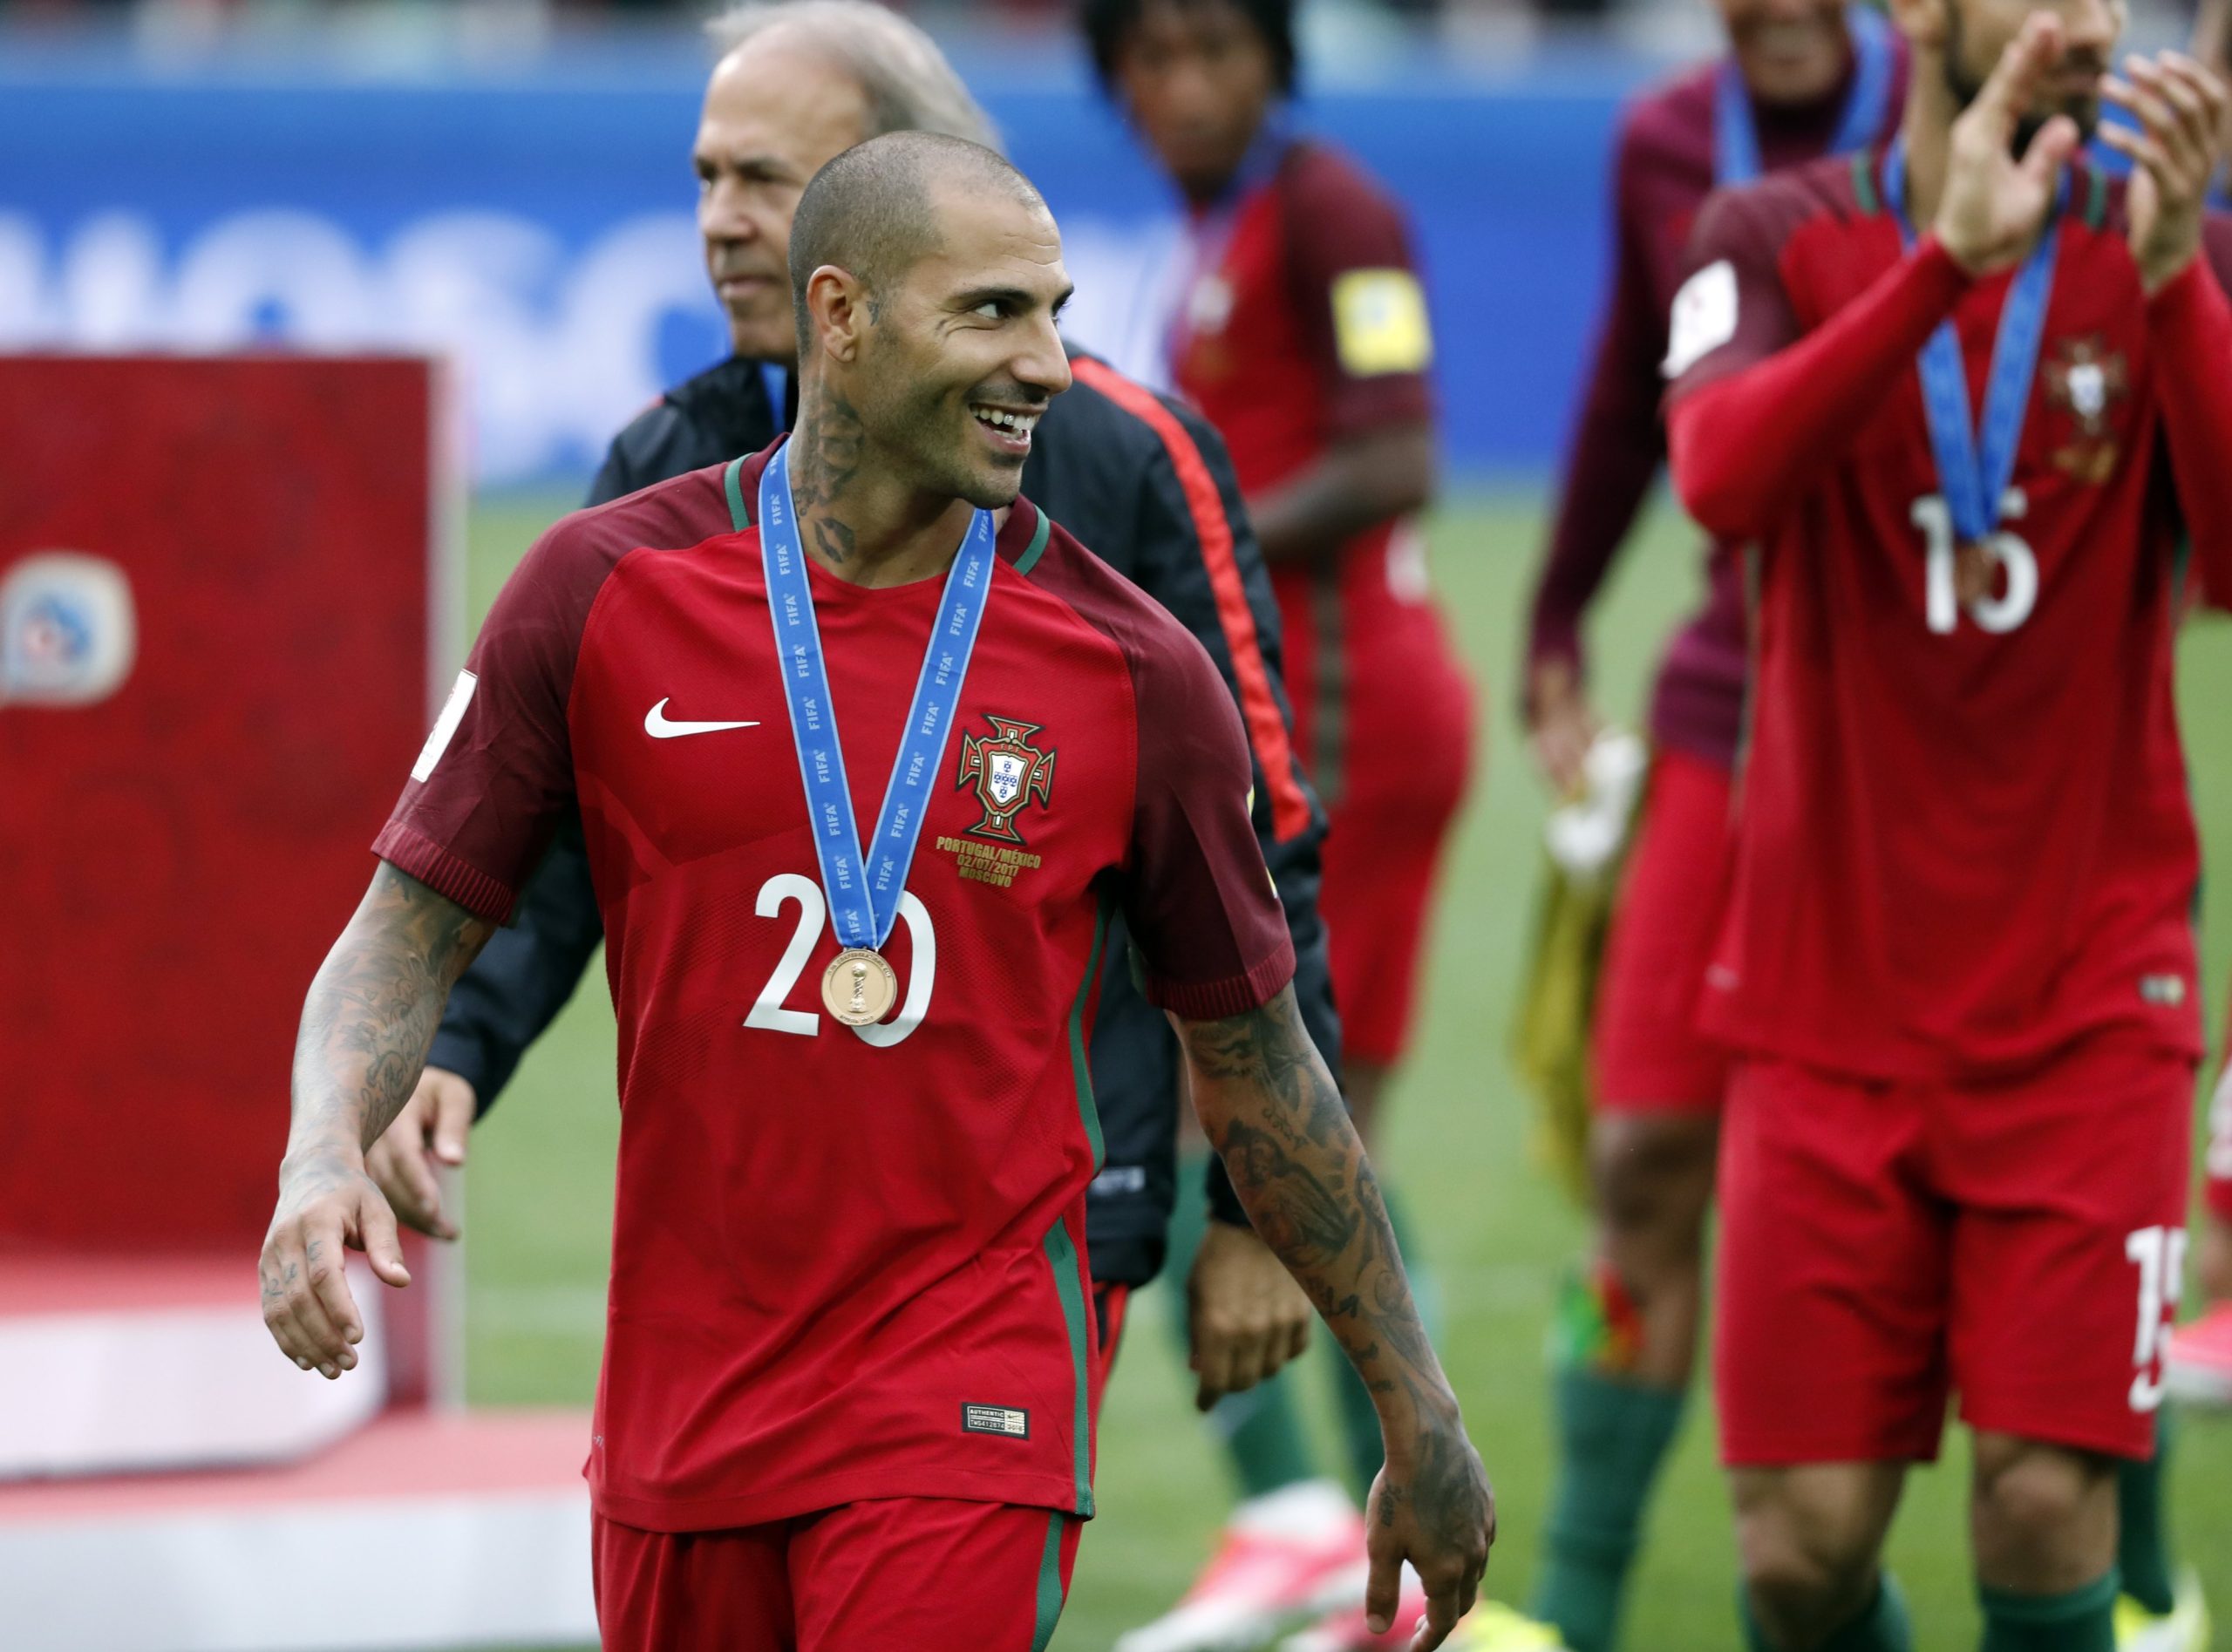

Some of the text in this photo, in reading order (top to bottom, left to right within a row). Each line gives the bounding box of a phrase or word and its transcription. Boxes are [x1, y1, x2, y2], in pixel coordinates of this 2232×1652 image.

[936, 836, 1041, 867] PORTUGAL/MÉXICO
[957, 857, 1019, 875] 02/07/2017
[959, 867, 1011, 887] MOSCOVO
[743, 874, 936, 1047] 20
[970, 1409, 1004, 1417] AUTHENTIC
